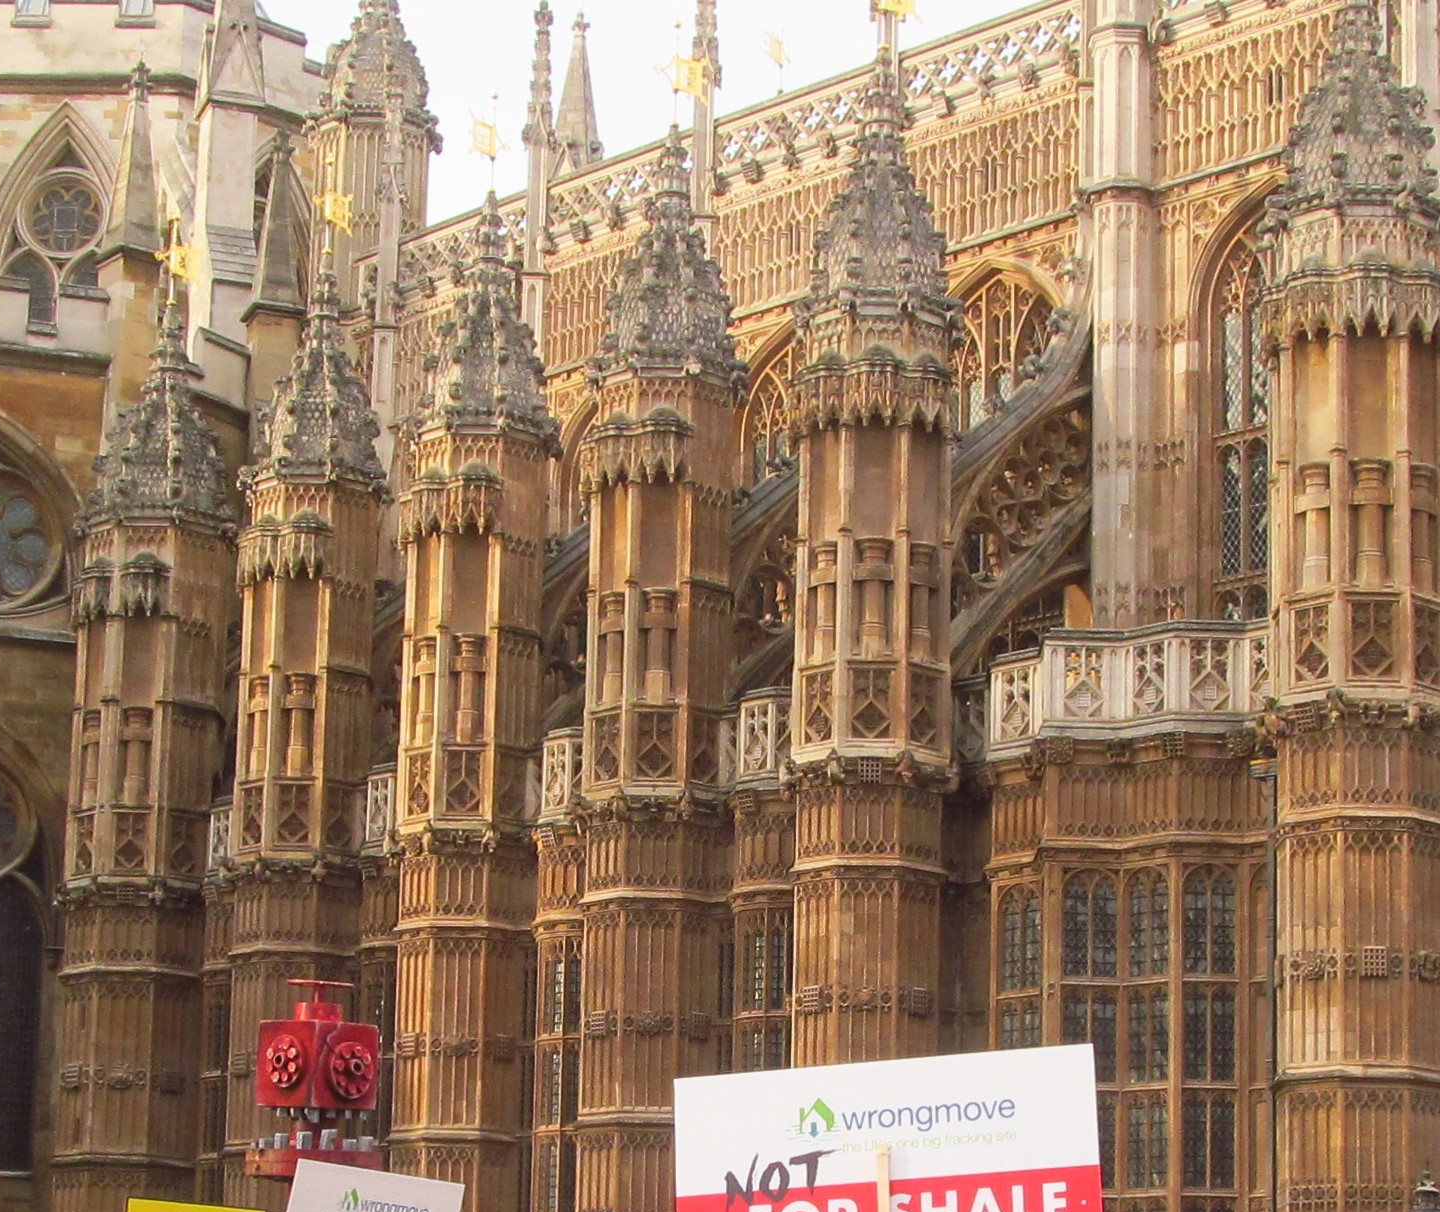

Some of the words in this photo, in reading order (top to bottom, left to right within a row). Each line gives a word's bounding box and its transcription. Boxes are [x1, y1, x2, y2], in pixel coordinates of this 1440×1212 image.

[841, 1098, 1017, 1132] wrongmove
[896, 1137, 920, 1150] one
[922, 1133, 942, 1148] big
[945, 1131, 993, 1147] fracking
[996, 1129, 1017, 1142] site
